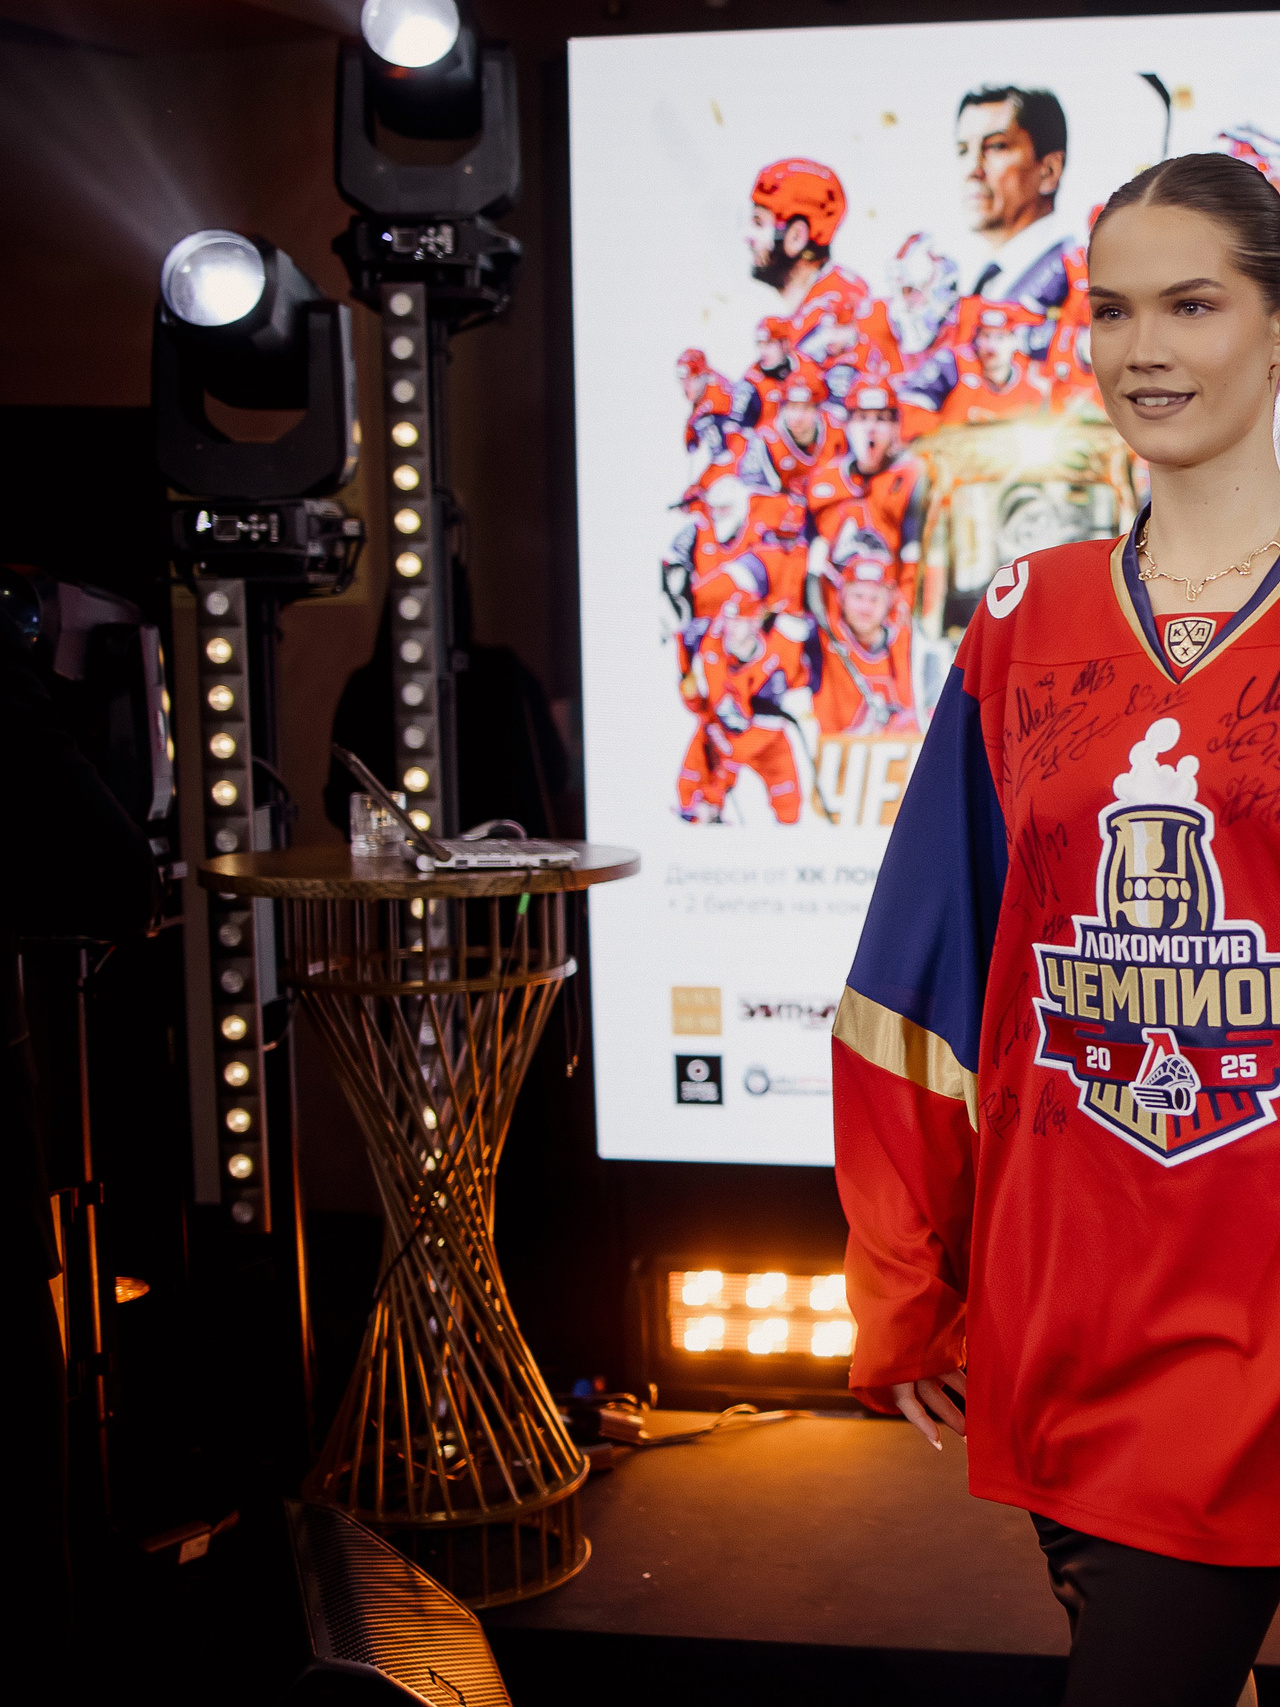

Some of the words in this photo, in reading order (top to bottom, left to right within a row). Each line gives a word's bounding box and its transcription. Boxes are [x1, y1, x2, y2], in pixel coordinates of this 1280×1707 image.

[1085, 931, 1251, 964] ЛОКОМОТИВ
[1086, 1045, 1111, 1071] 20
[1220, 1054, 1257, 1079] 25
